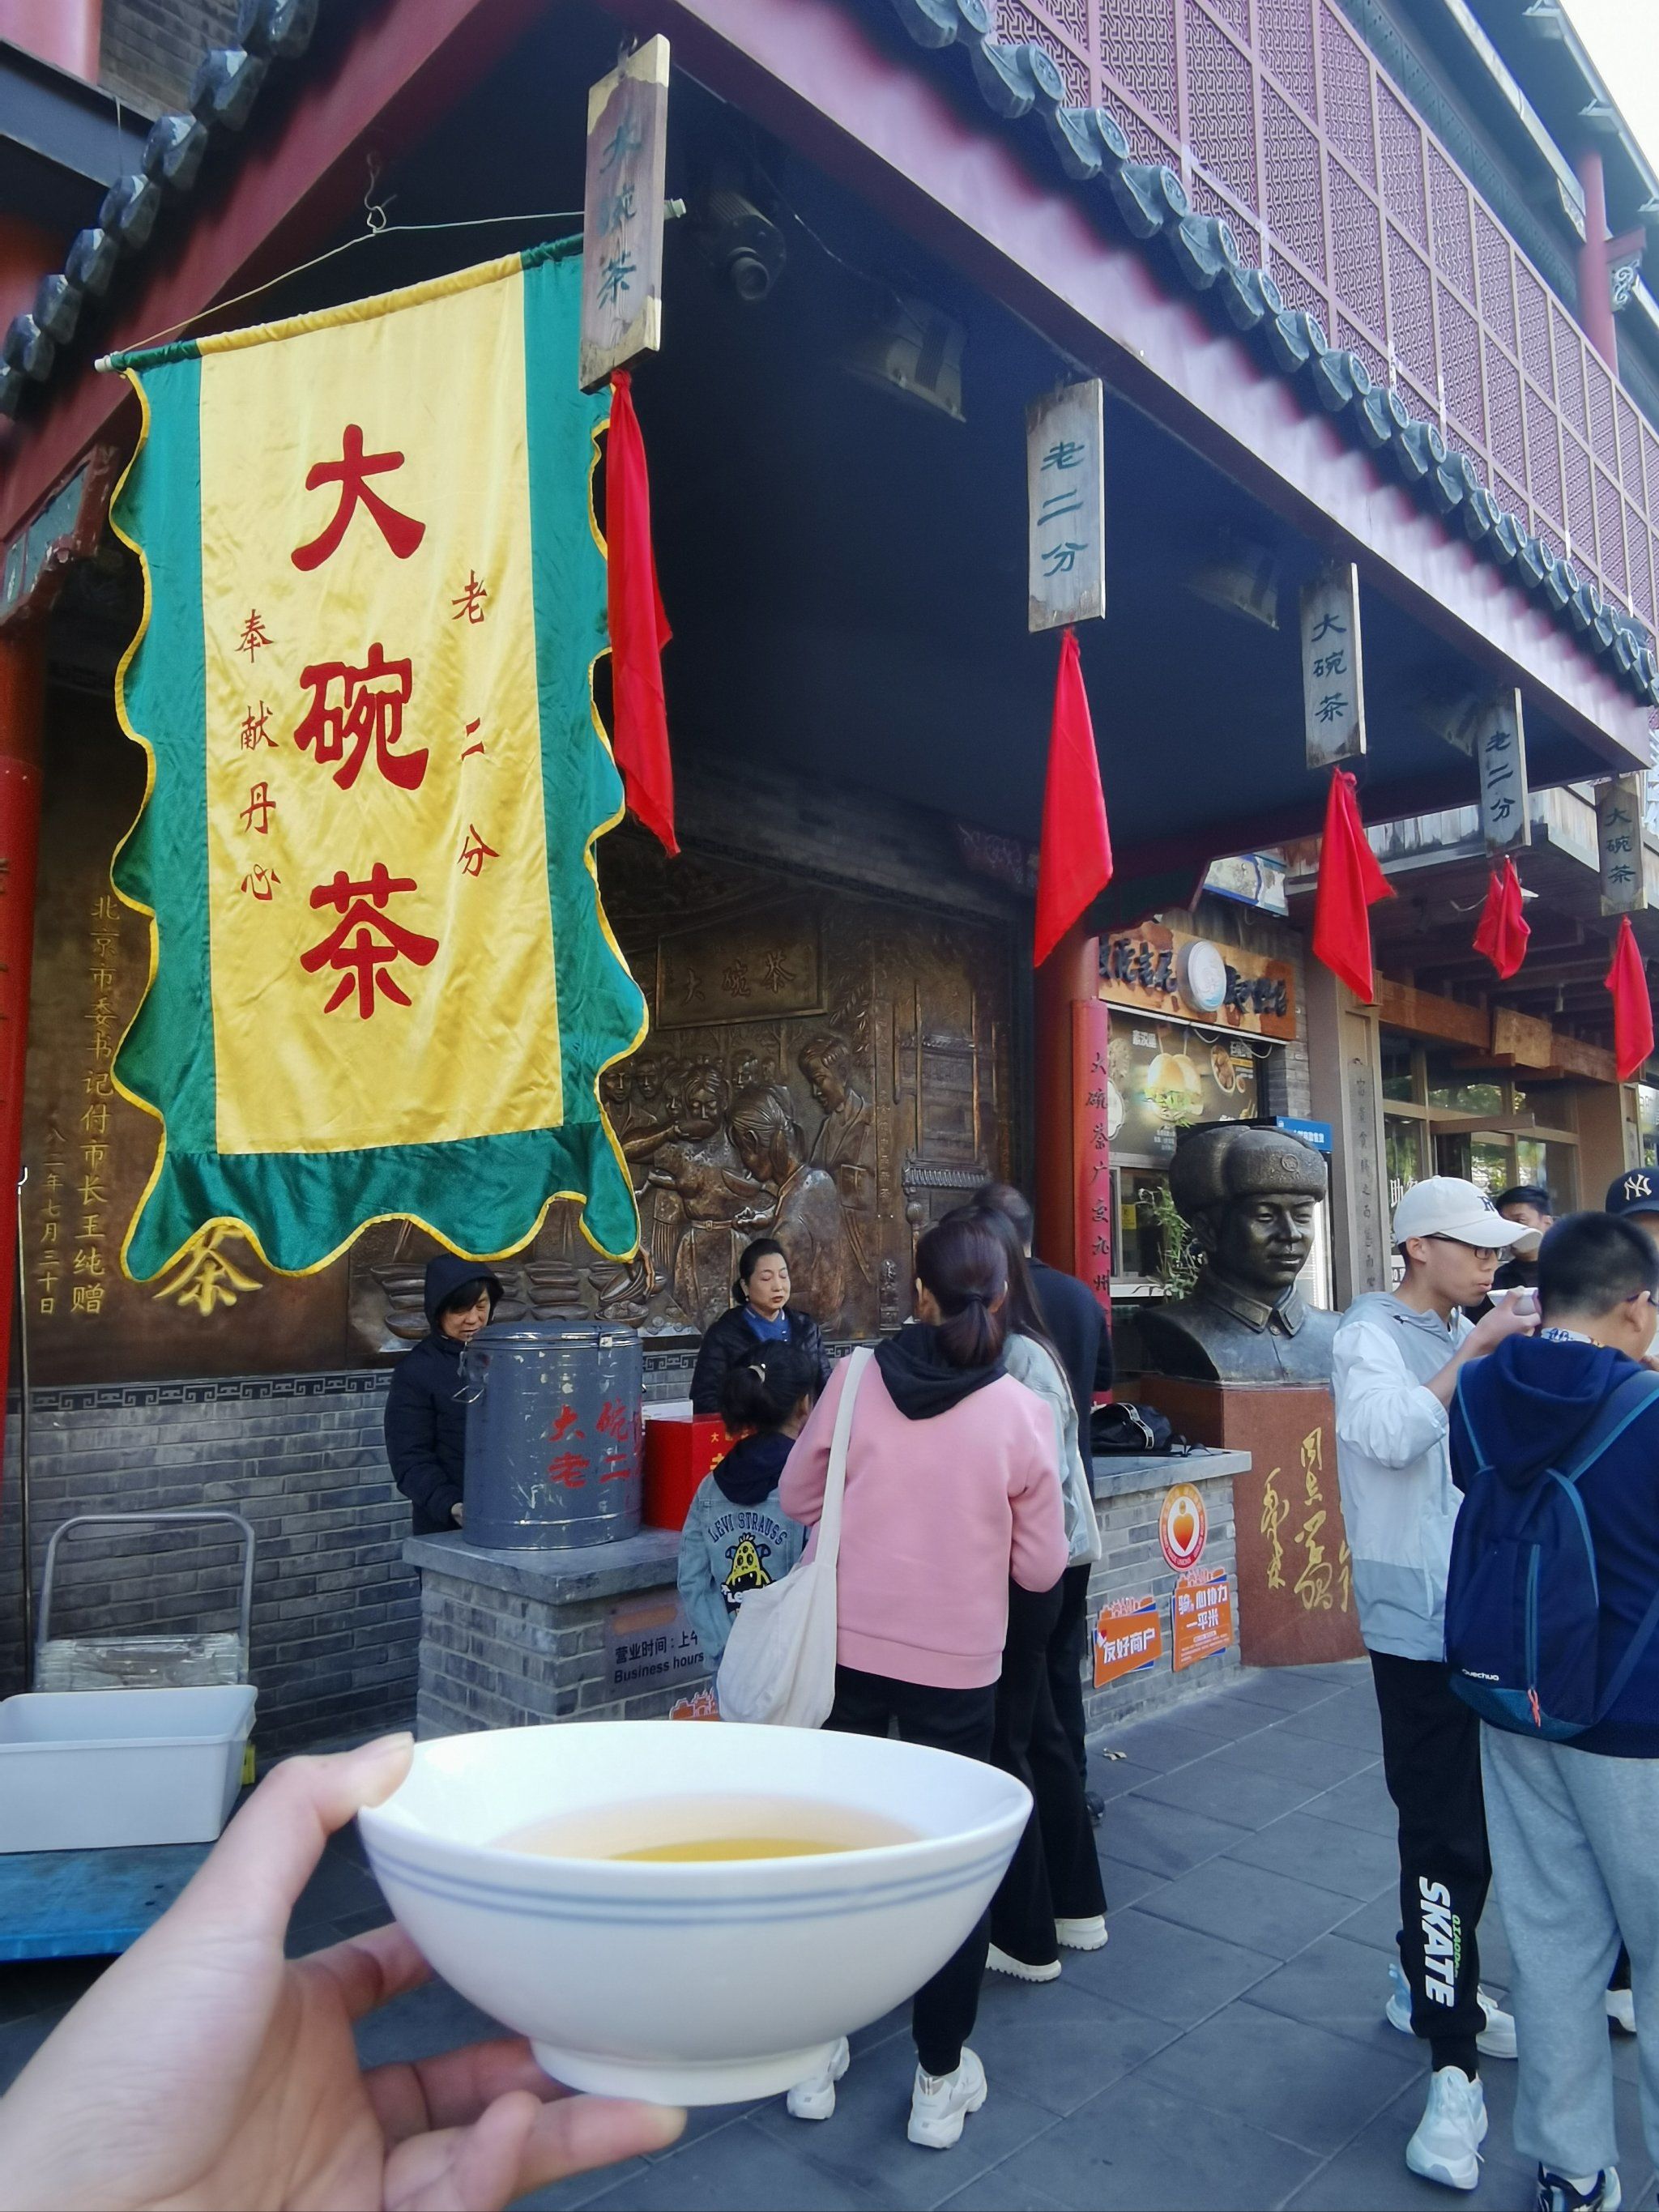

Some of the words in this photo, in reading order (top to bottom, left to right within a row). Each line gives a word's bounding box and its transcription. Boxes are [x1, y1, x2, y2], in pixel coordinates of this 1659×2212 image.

[1037, 441, 1089, 578] 老二分
[290, 423, 439, 1021] 大碗茶
[451, 570, 501, 878] 老二分
[1310, 613, 1349, 724] 大碗茶
[234, 607, 281, 902] 奉献丹心
[1486, 730, 1516, 823] 老二分
[1605, 808, 1638, 885] 大碗茶
[708, 1513, 735, 1543] LEVI
[738, 1511, 787, 1545] STRAUSS
[614, 1660, 670, 1684] Business
[673, 1652, 704, 1669] hours
[1418, 1876, 1455, 2008] SKATE
